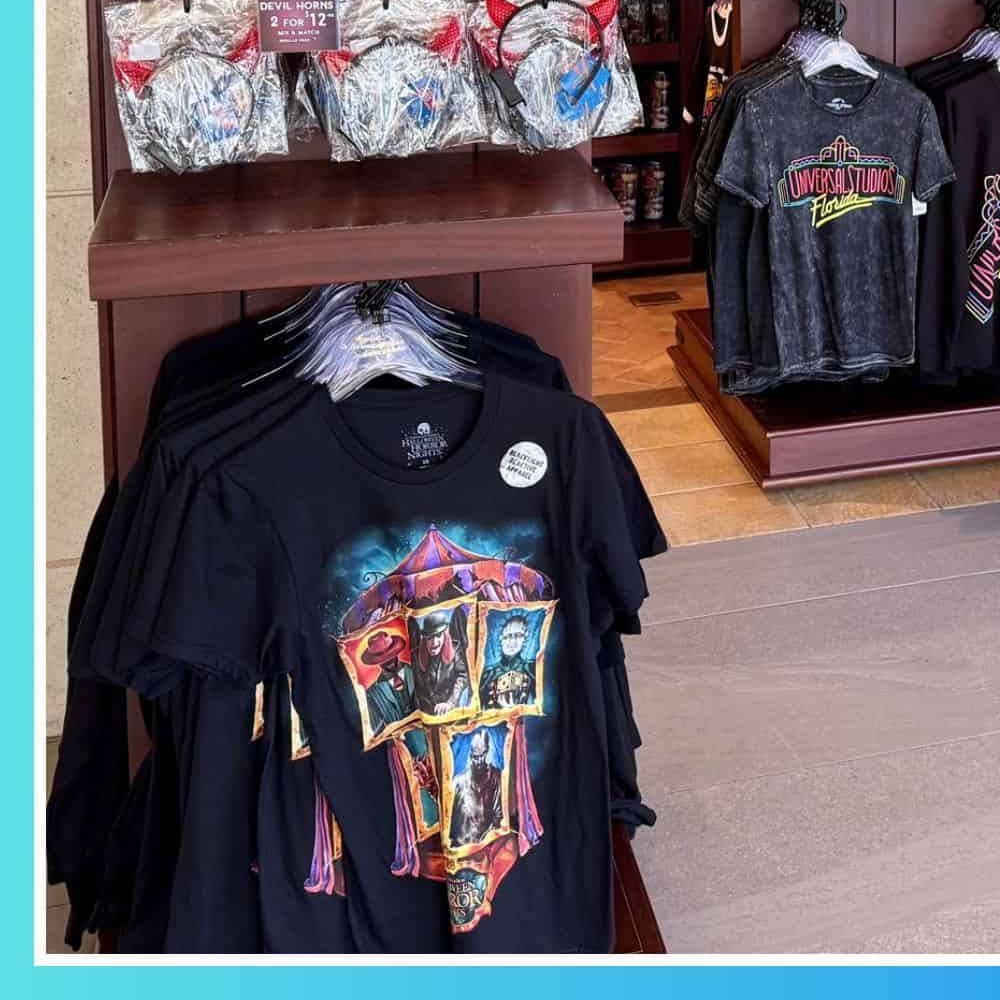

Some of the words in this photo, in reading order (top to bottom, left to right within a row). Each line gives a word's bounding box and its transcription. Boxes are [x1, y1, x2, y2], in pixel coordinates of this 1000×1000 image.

[260, 1, 292, 11] DEVIL
[296, 1, 334, 10] HORNS
[270, 16, 278, 27] 2
[283, 18, 304, 27] FOR
[788, 168, 849, 200] UNIVERSAL
[847, 165, 896, 195] STUDIOS
[811, 191, 874, 228] Florida
